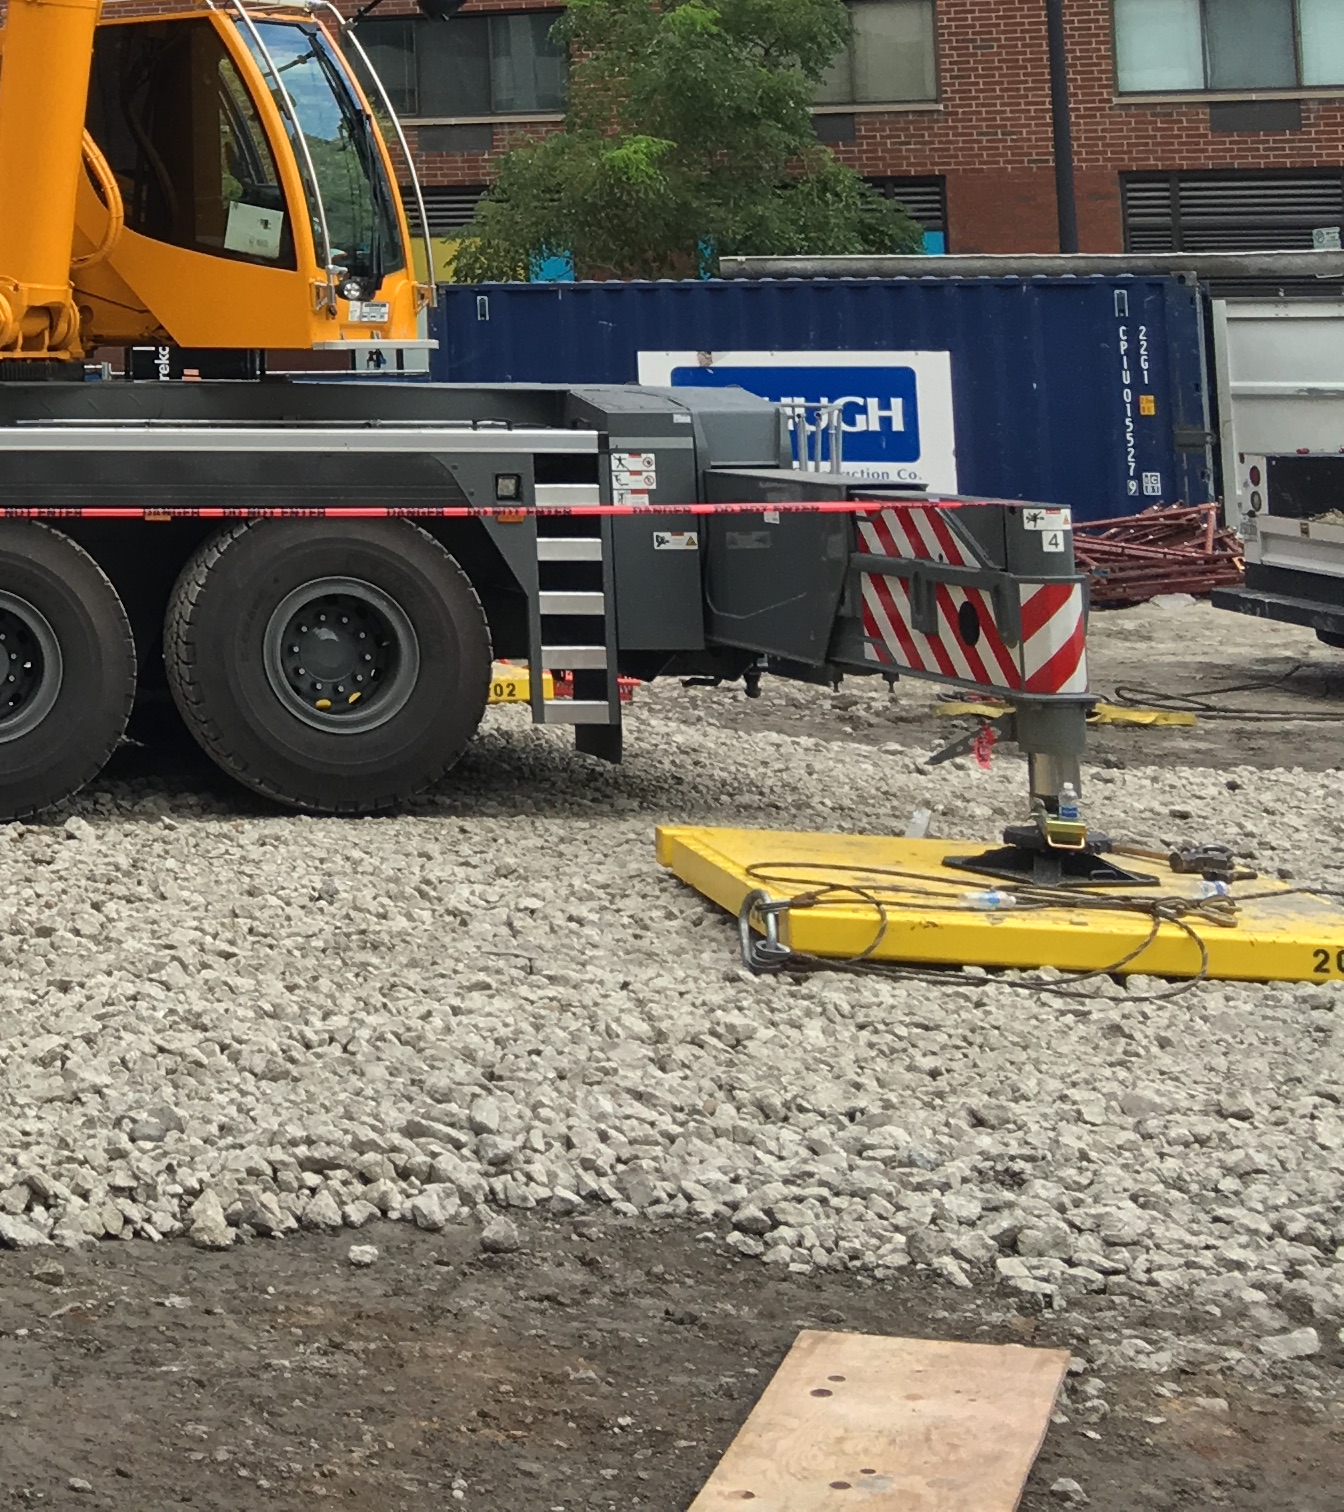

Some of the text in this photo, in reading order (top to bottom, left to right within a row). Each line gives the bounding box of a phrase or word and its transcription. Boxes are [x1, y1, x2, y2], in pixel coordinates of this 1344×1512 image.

[1138, 325, 1149, 385] 22G1
[897, 468, 923, 481] Co.
[1048, 533, 1060, 549] 4
[490, 683, 517, 698] 02
